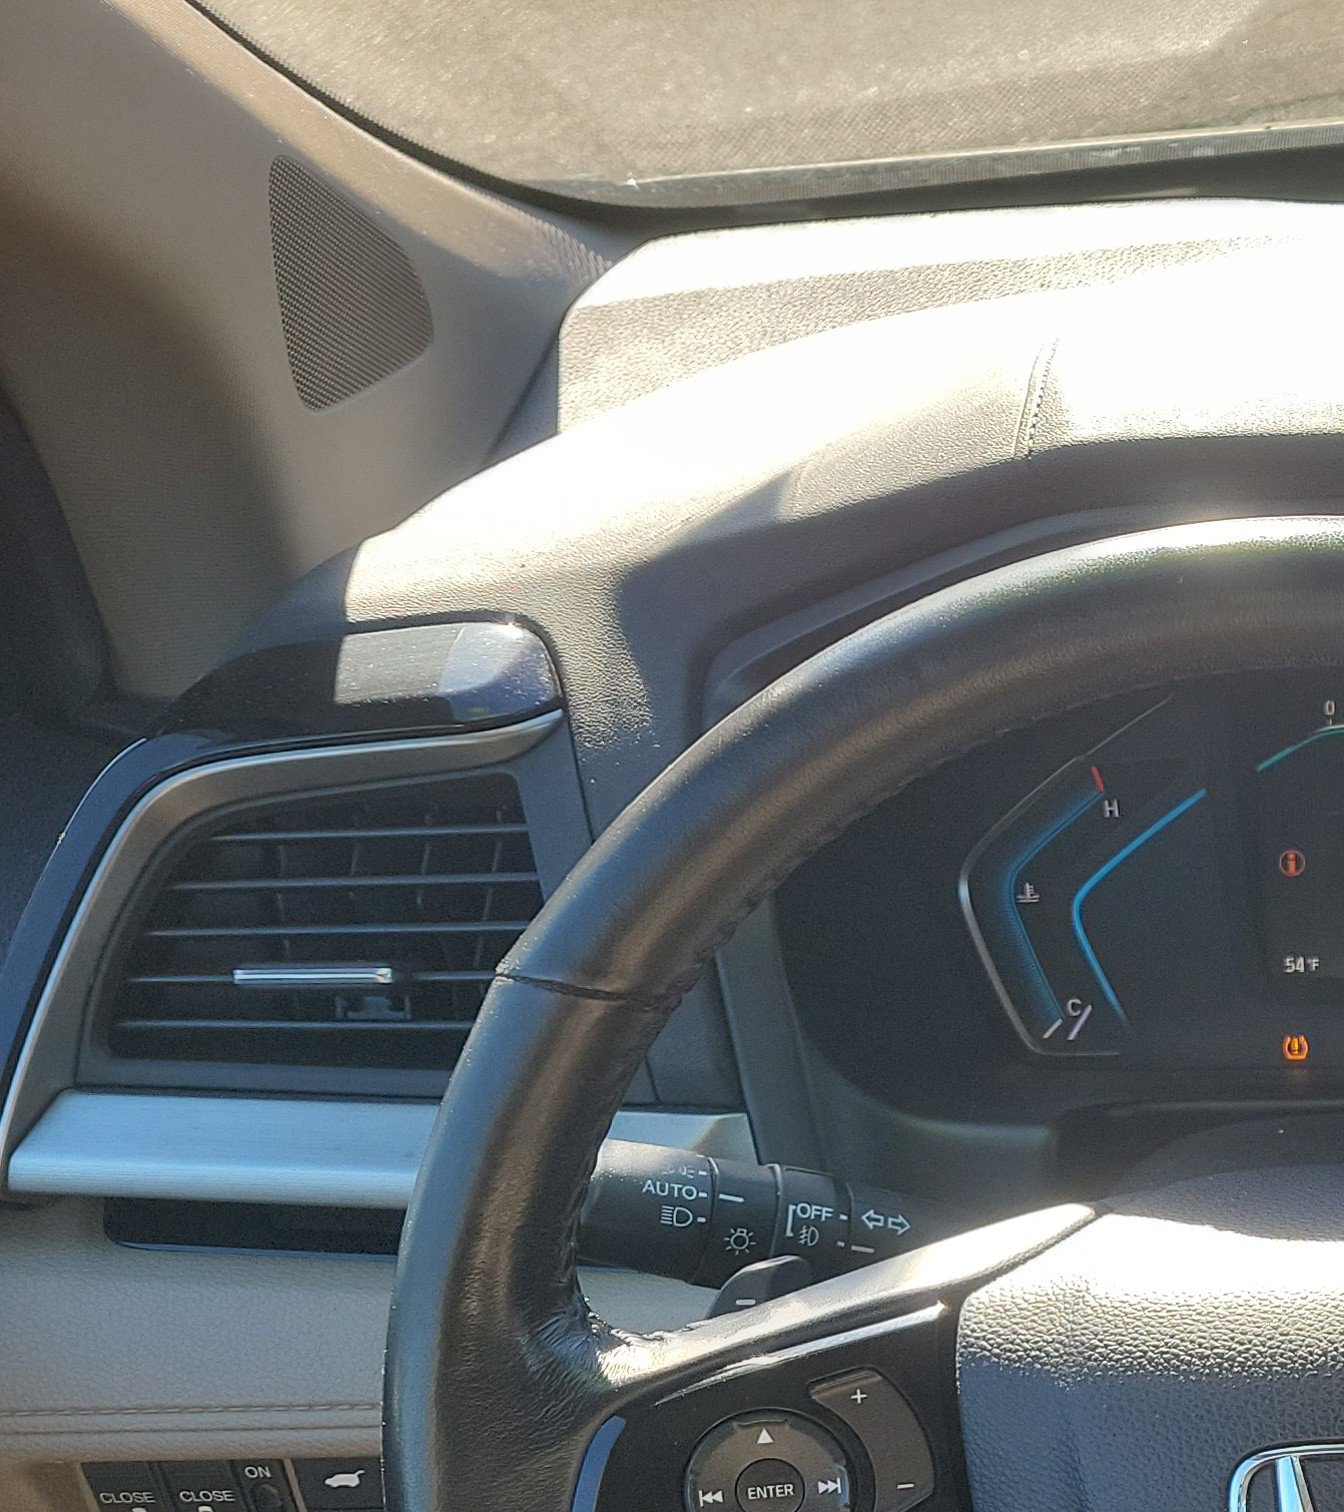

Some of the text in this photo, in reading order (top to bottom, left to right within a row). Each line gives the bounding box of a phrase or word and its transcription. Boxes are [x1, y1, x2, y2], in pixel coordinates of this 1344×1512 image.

[1324, 700, 1335, 715] 0
[1104, 800, 1119, 817] H
[1067, 1000, 1081, 1016] C
[642, 1179, 697, 1201] AUTO
[796, 1202, 834, 1222] OFF
[244, 1466, 271, 1478] ON
[100, 1492, 155, 1504] CLOSE
[179, 1490, 235, 1502] CLOSE
[747, 1482, 794, 1500] ENTER
